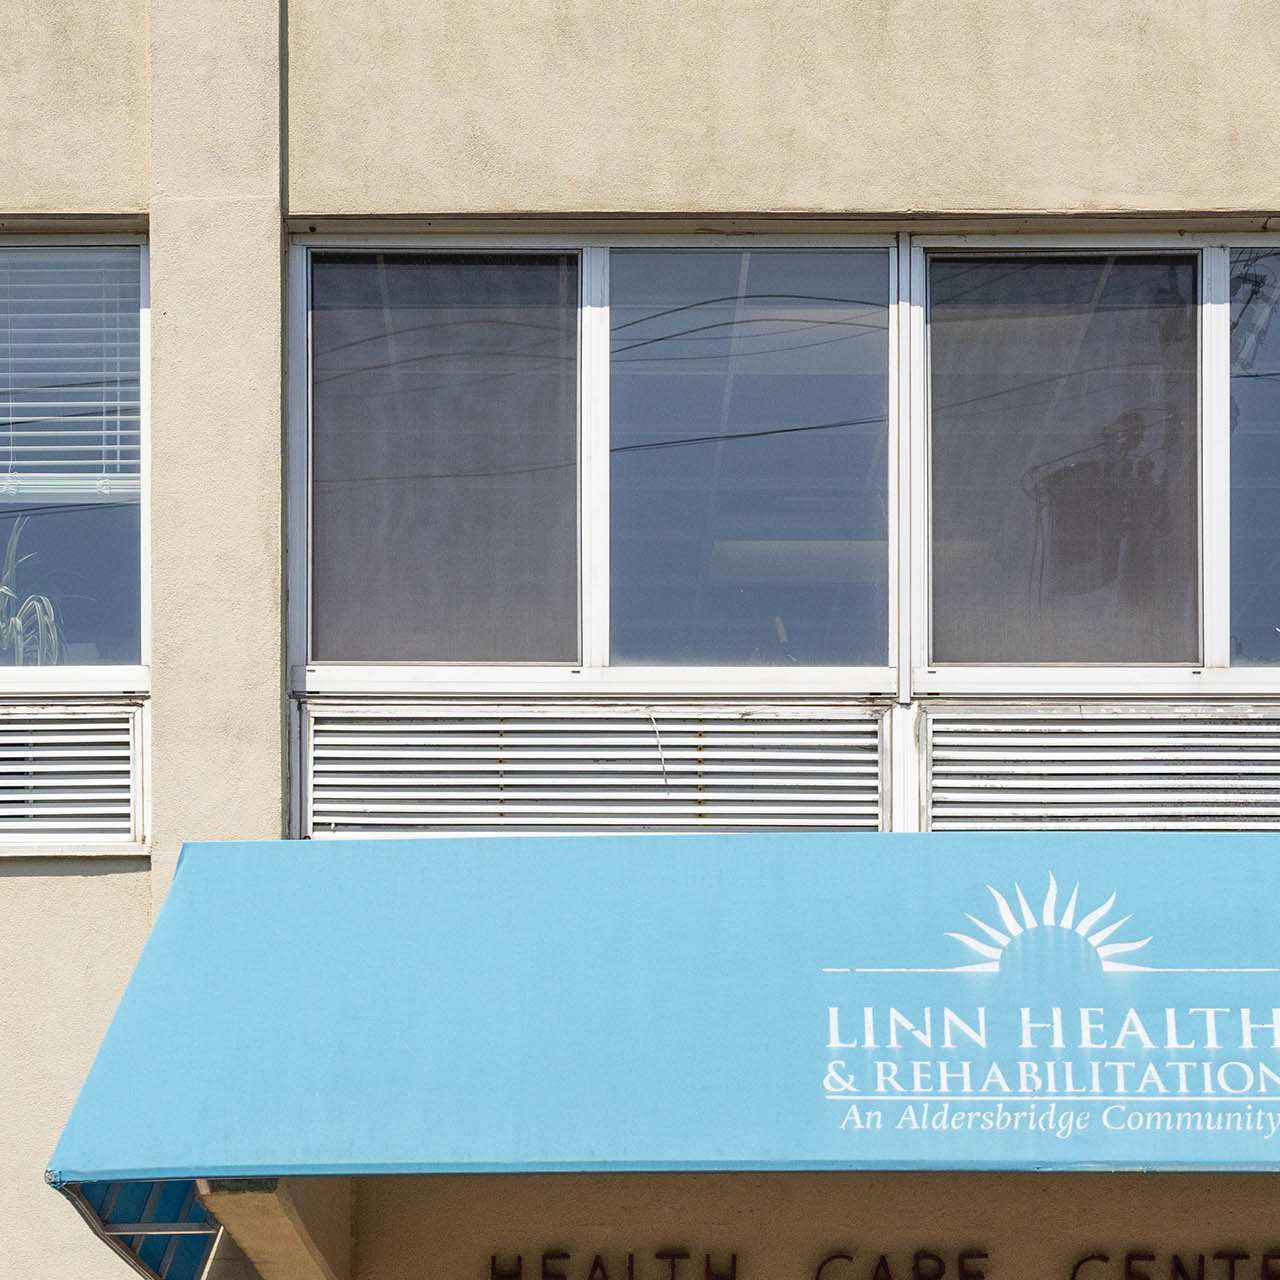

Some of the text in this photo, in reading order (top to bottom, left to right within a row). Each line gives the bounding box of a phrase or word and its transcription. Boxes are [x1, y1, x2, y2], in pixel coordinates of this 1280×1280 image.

[825, 1006, 987, 1049] LINN
[822, 1059, 860, 1094] &
[840, 1104, 883, 1131] An
[896, 1101, 1091, 1139] Aldersbridge
